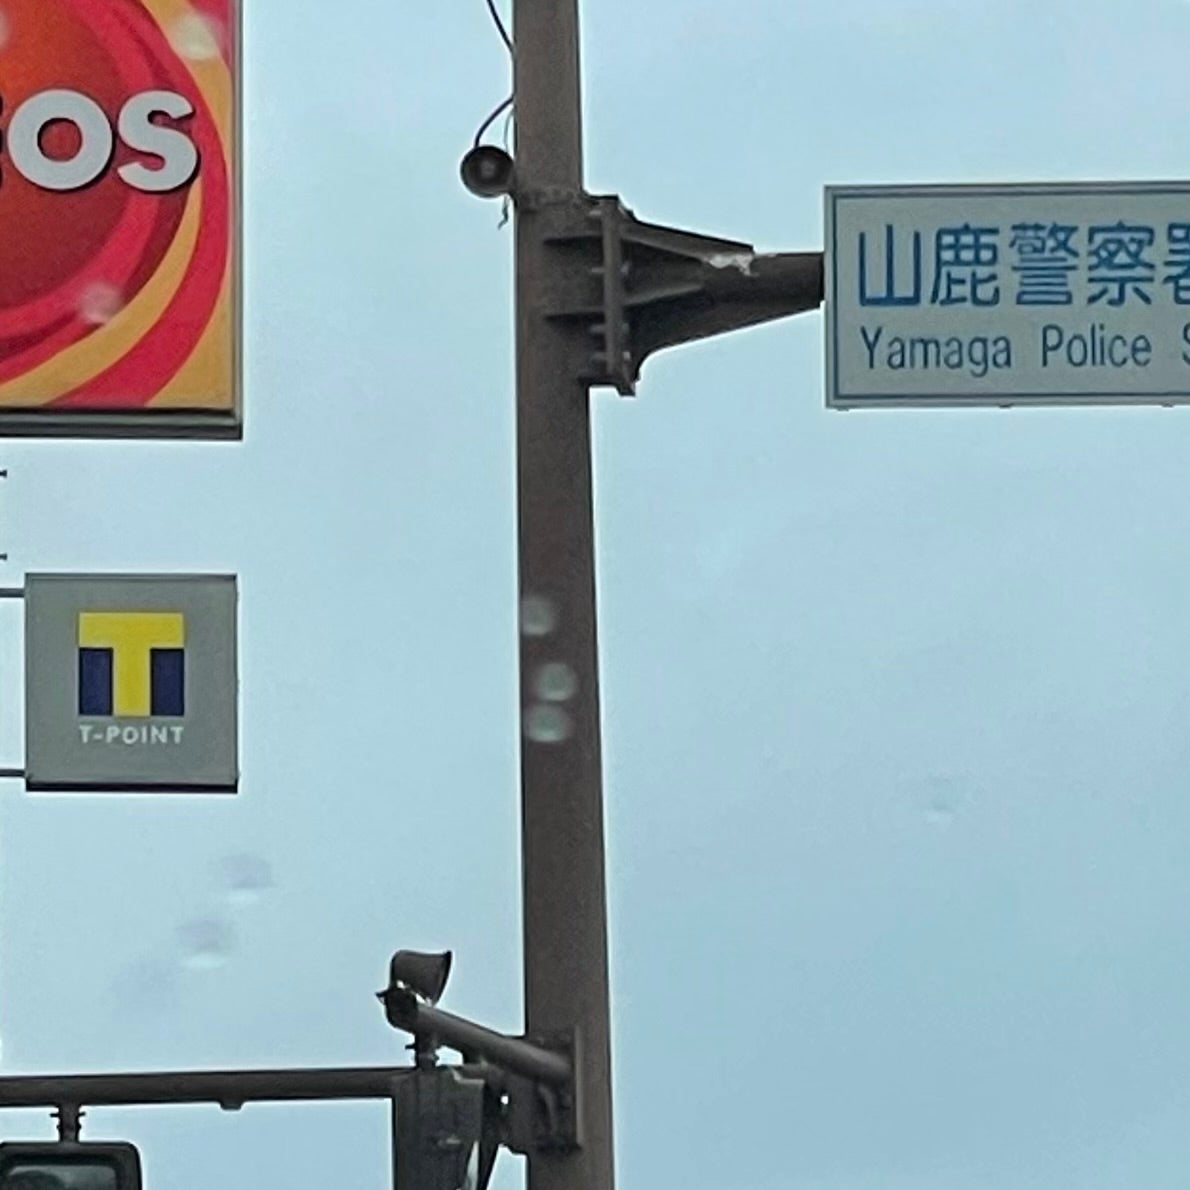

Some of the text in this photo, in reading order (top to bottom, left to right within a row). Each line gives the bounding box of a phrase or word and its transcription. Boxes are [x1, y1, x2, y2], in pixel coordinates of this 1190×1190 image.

[860, 325, 1012, 378] Yamaga
[1041, 323, 1152, 369] Police
[78, 725, 185, 745] T-POINT
